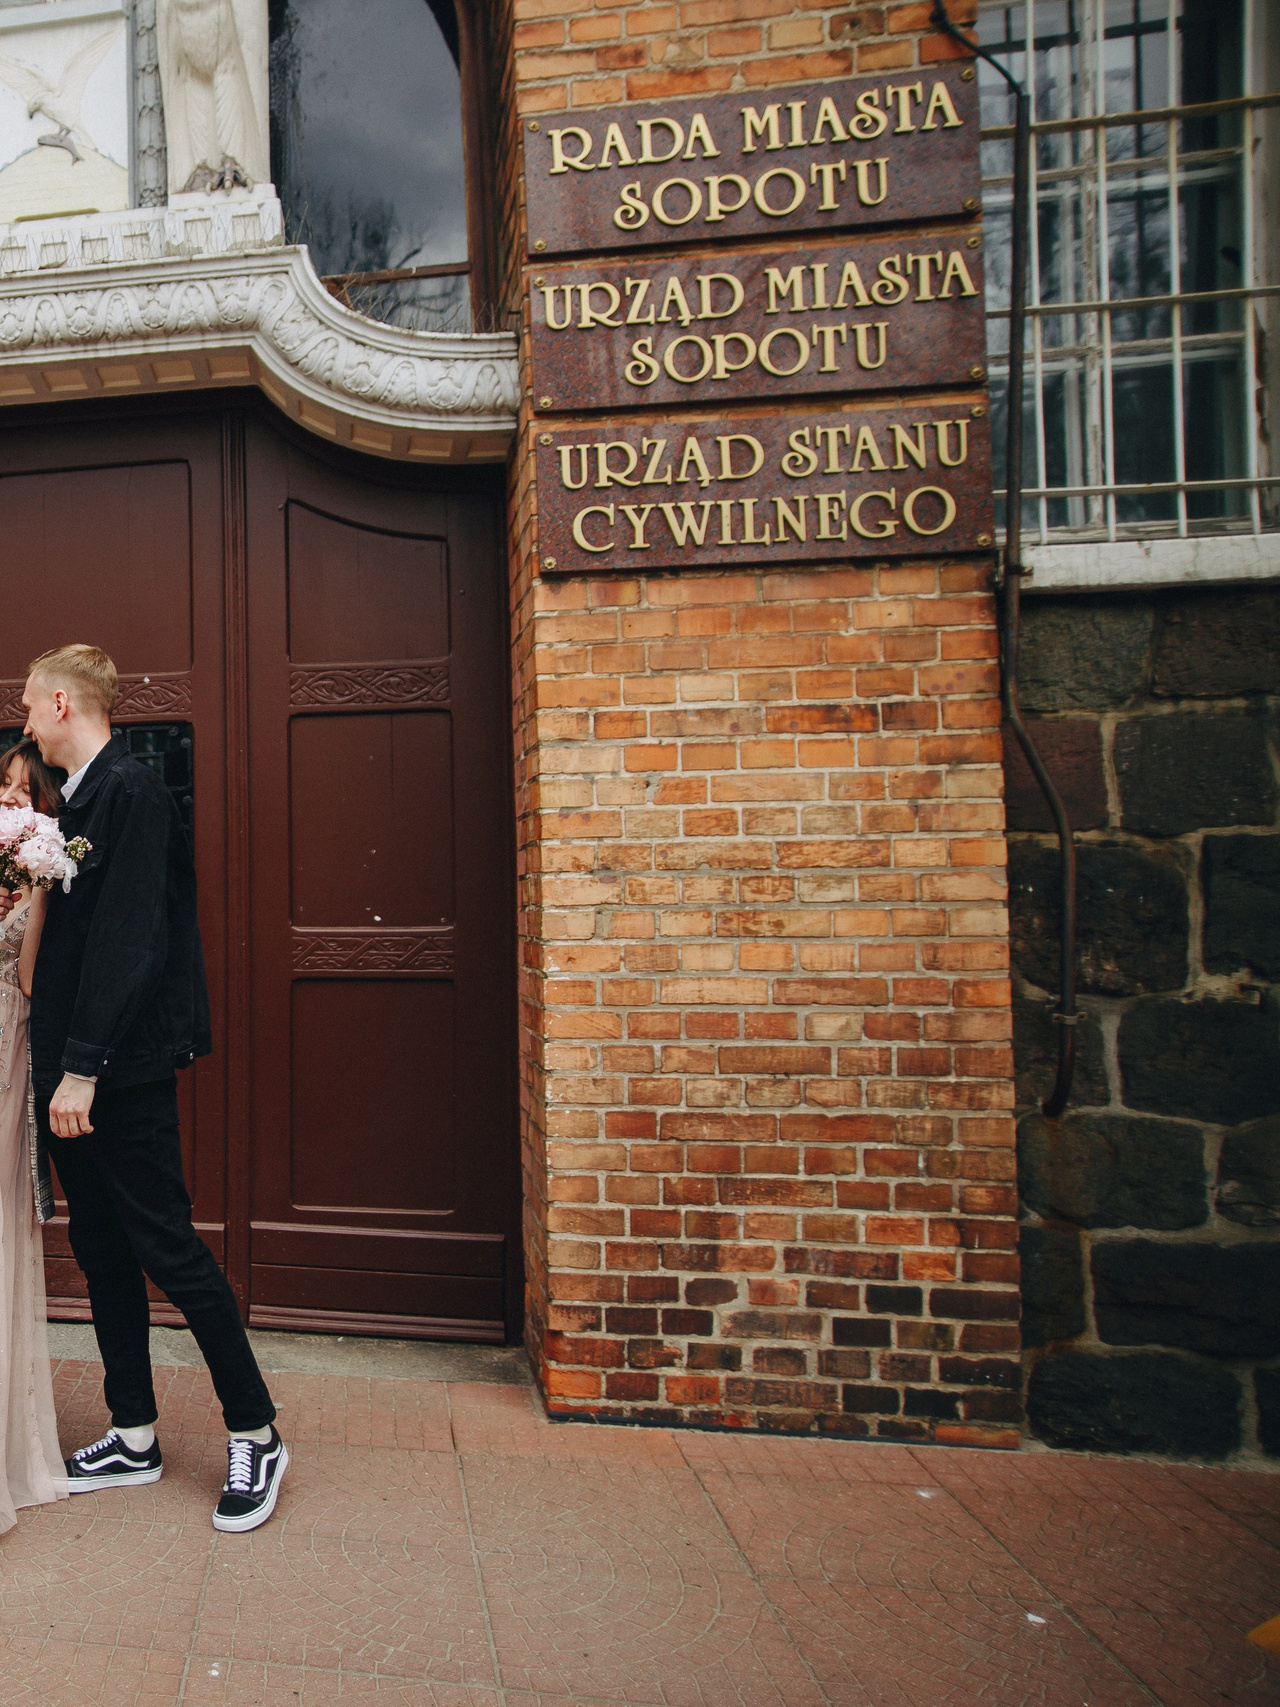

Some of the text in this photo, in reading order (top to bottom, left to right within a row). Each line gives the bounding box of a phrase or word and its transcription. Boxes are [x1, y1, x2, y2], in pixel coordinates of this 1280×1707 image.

[546, 80, 965, 175] RADA MIASTA
[613, 157, 890, 230] SOPOTU
[540, 249, 979, 331] URZĄD MIASTA
[624, 322, 890, 386] SOPOTU
[556, 418, 971, 490] URZĄD STANU
[572, 485, 957, 553] CYWILNEGO
